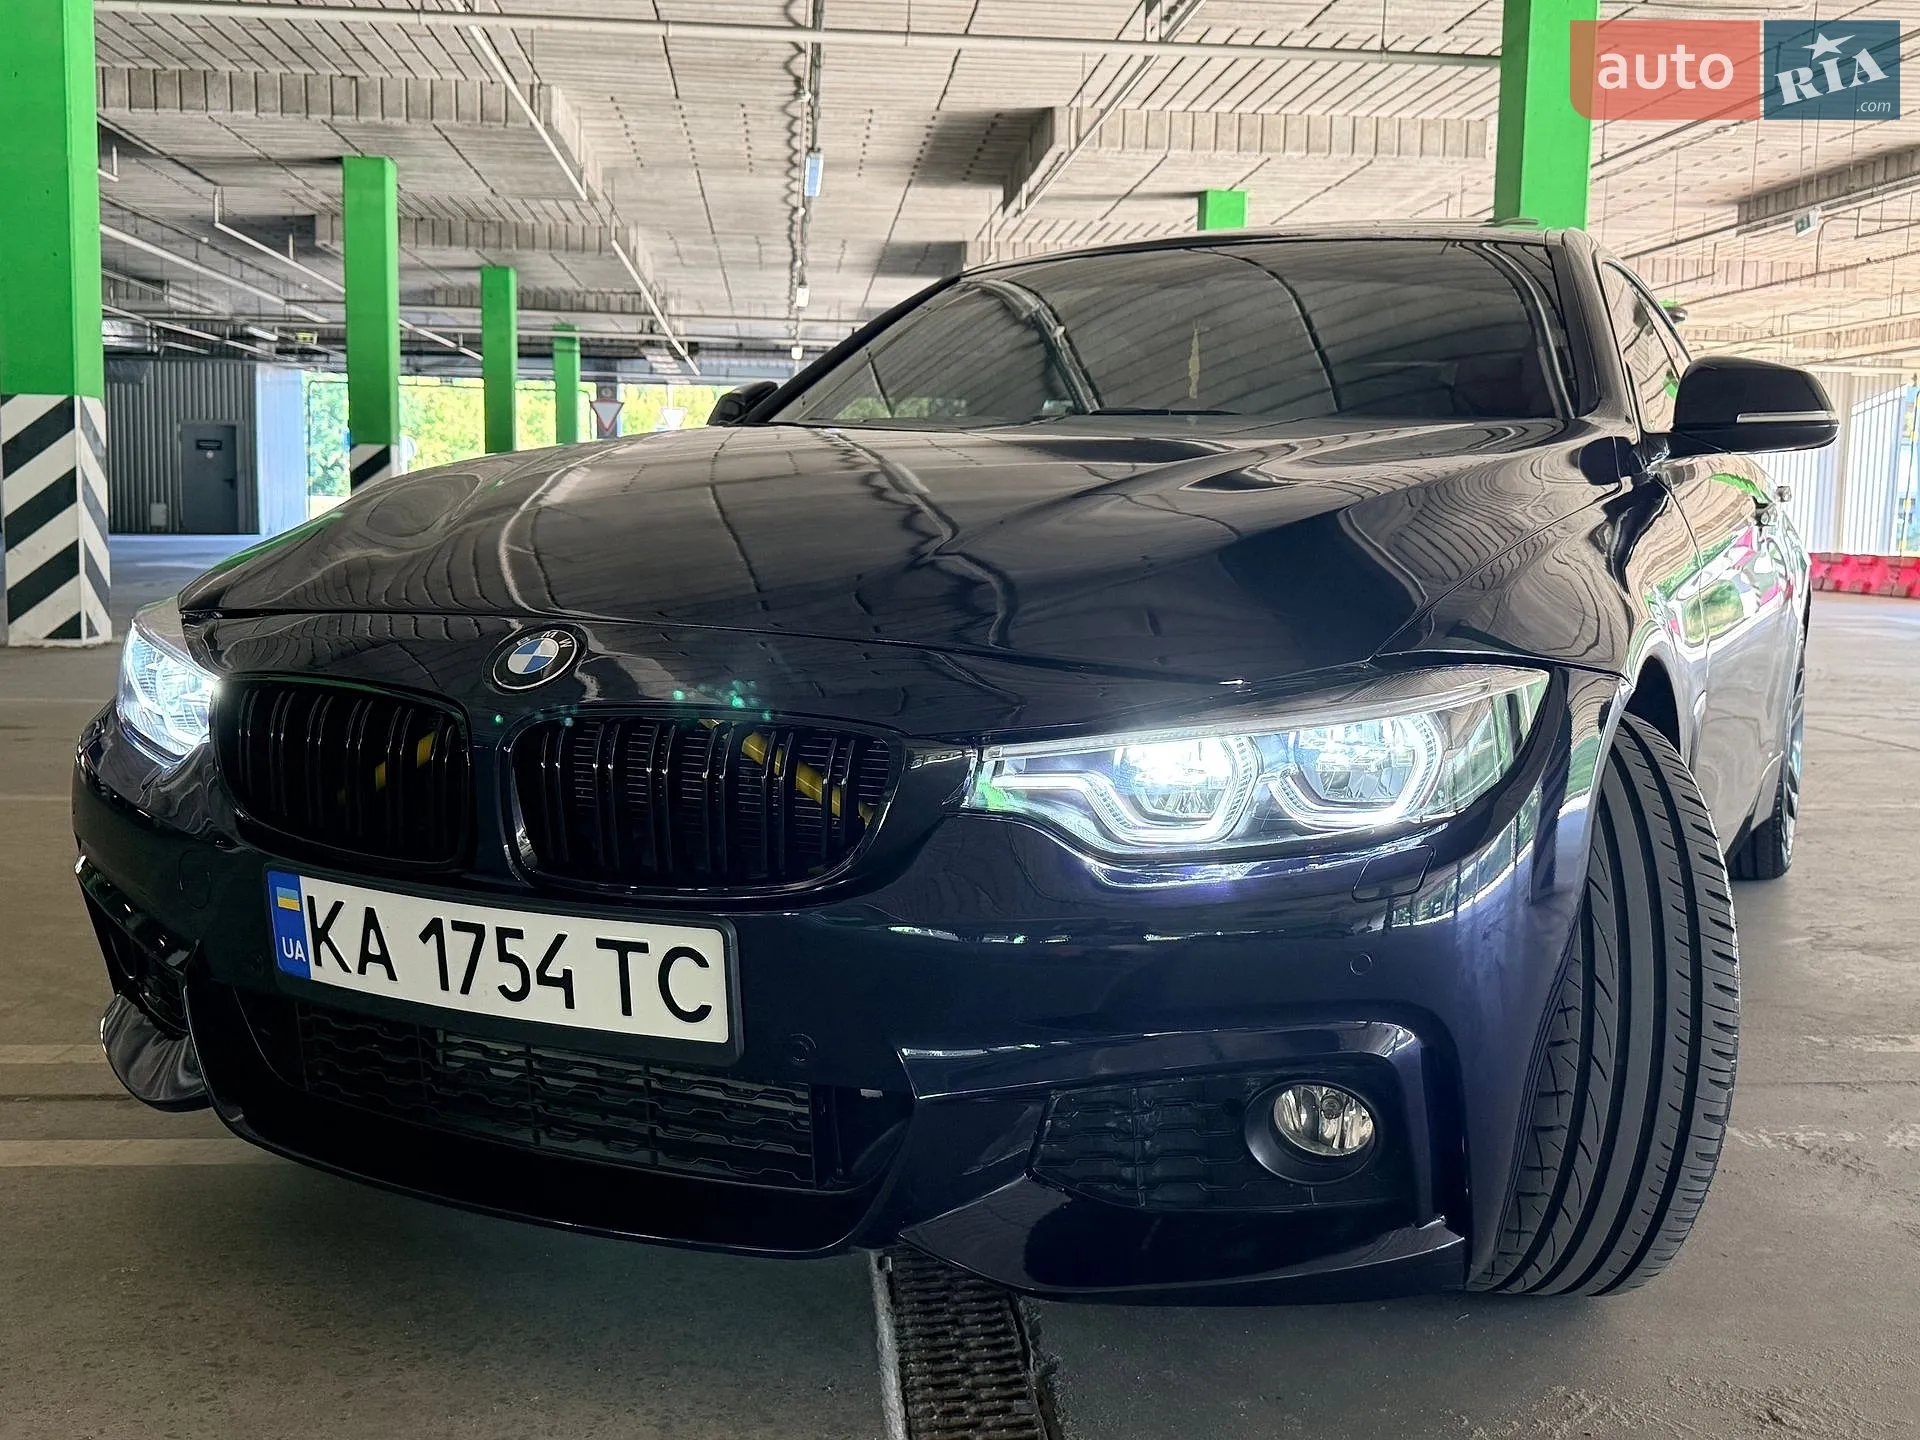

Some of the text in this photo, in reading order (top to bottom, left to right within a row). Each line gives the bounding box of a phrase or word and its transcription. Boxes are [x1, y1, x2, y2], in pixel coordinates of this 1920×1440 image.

[516, 630, 573, 648] BMW
[281, 936, 307, 963] UA
[306, 894, 713, 1024] KA 1754 TC
